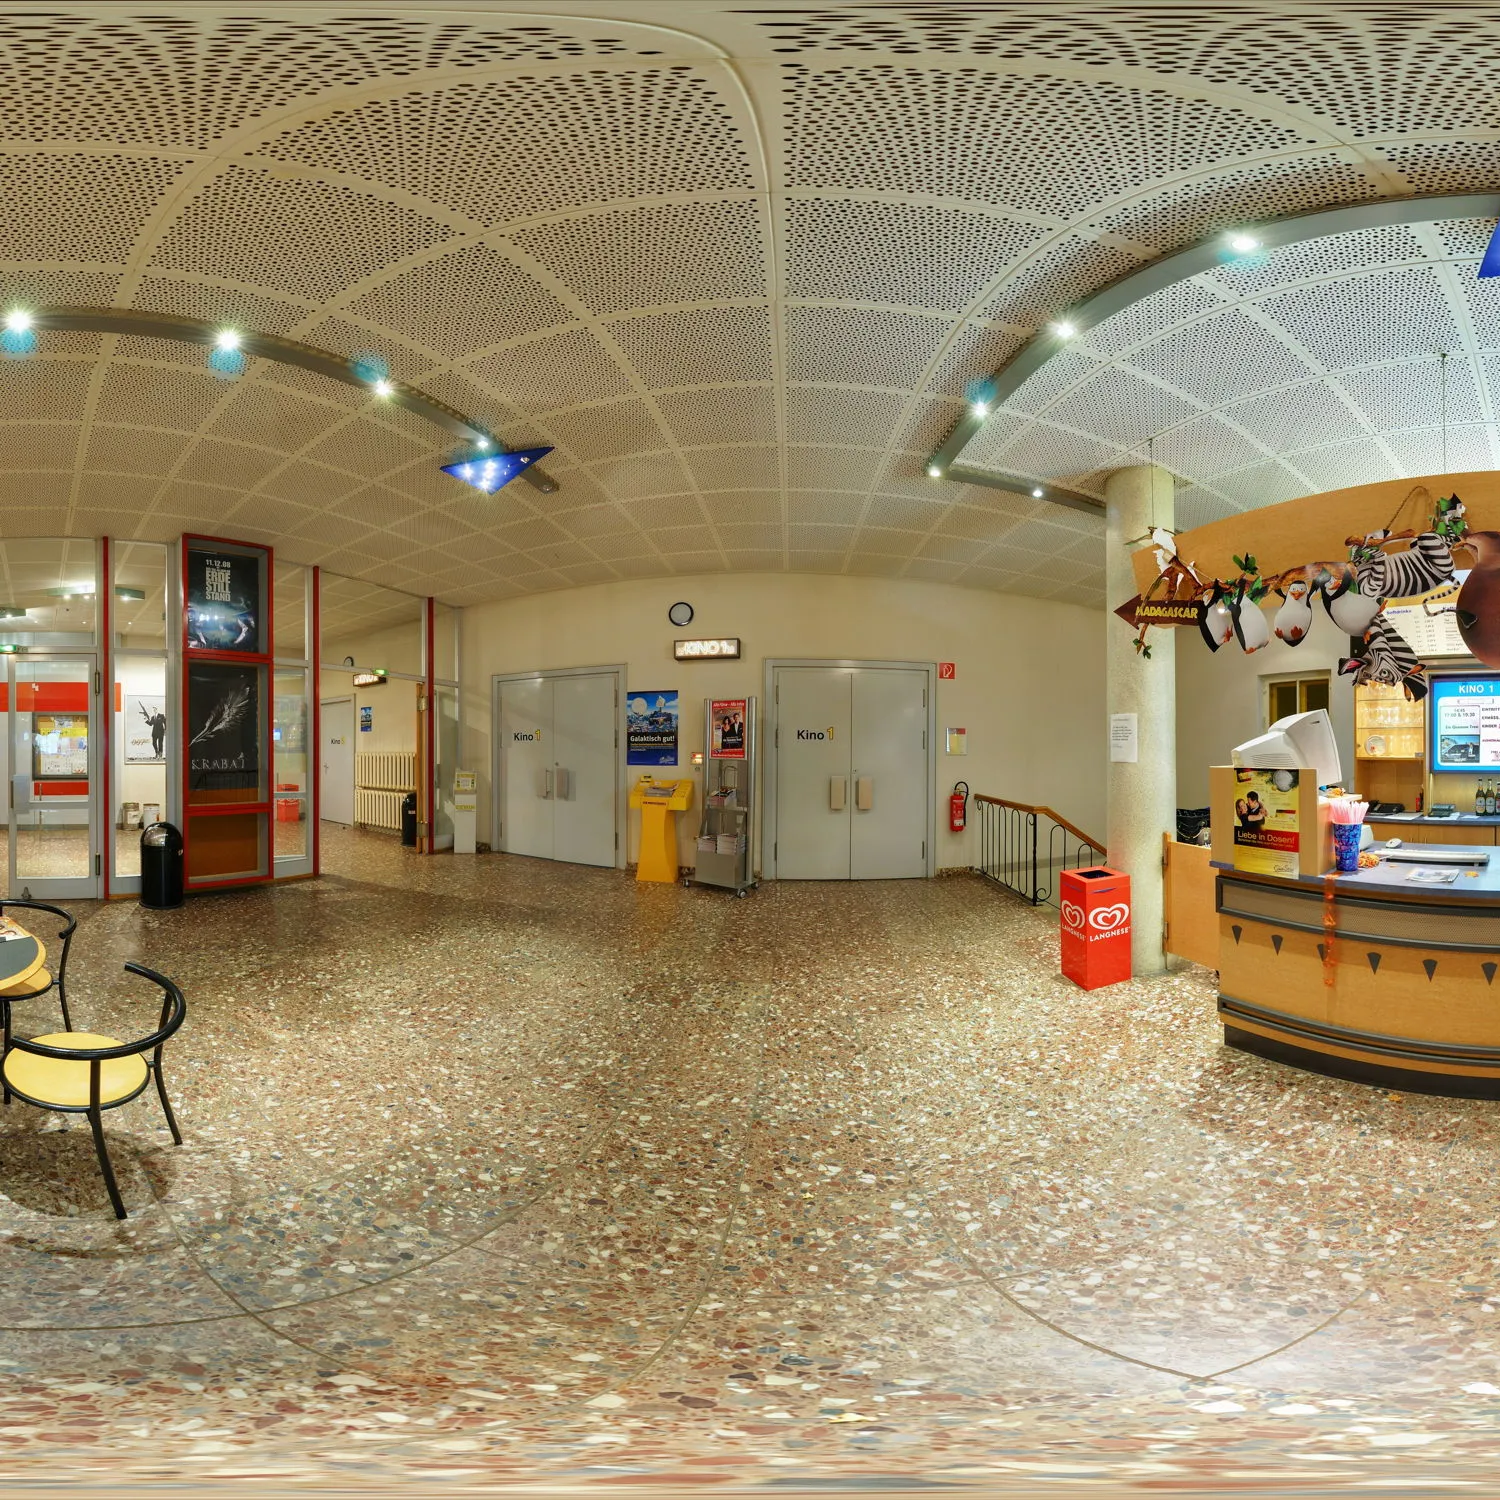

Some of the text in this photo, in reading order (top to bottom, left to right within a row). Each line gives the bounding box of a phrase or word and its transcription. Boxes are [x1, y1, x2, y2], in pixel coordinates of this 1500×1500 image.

[205, 569, 231, 584] ERDE
[205, 581, 231, 594] STILL
[205, 589, 231, 602] STAND
[1135, 605, 1199, 619] MADAGASCAR
[684, 640, 720, 656] KINO
[1459, 684, 1495, 693] KINO 1
[513, 729, 541, 742] Kino 1
[662, 735, 675, 743] gut!
[796, 726, 834, 741] Kino 1
[191, 752, 245, 770] KRABAT
[1237, 830, 1257, 840] Liebe
[1267, 834, 1295, 845] Dosen!
[1089, 927, 1130, 942] LANGNESE
